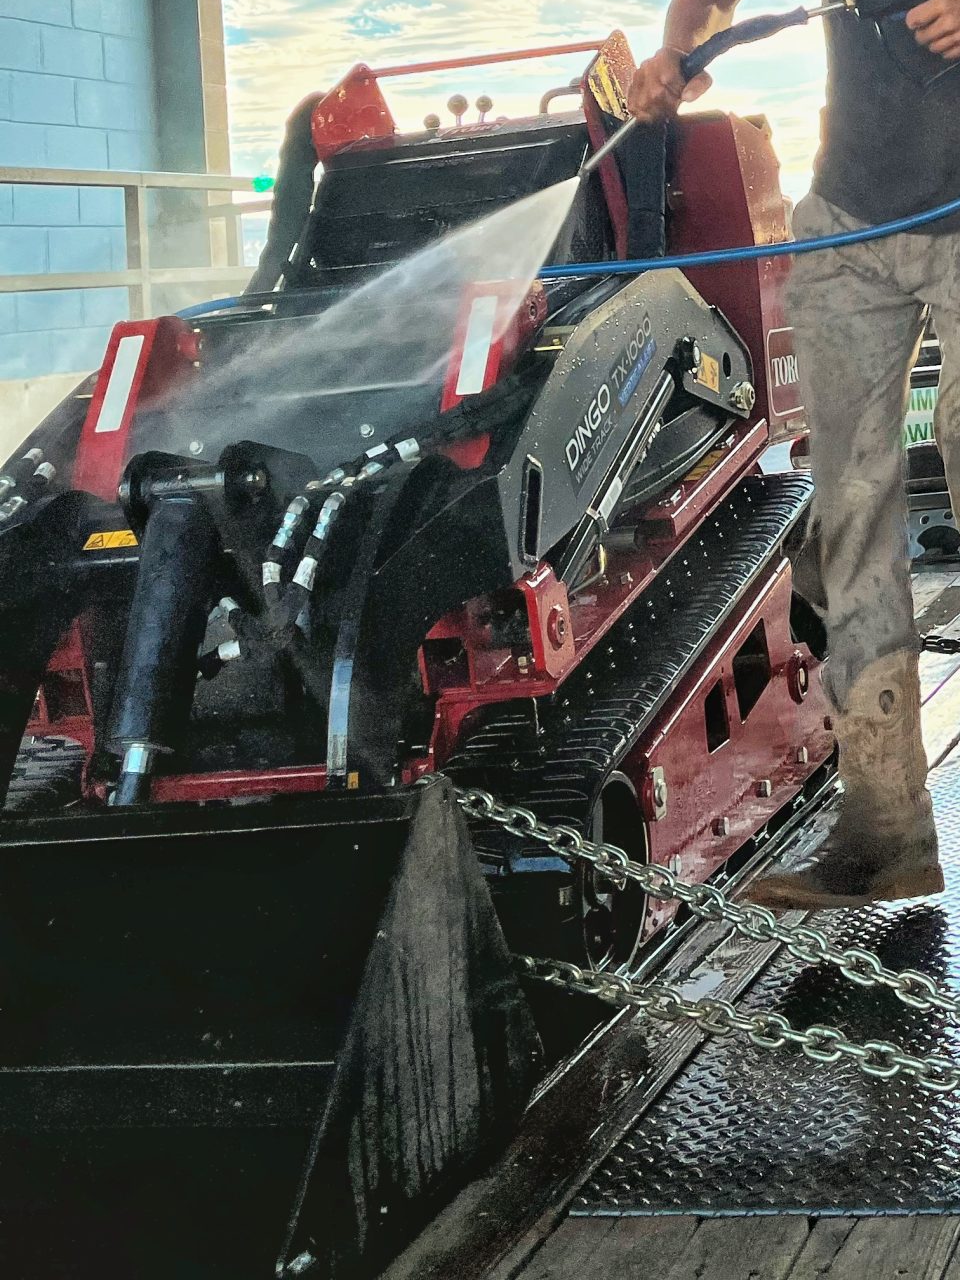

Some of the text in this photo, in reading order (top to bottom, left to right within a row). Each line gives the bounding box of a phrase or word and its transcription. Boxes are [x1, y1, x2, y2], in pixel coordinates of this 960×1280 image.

[771, 354, 800, 388] TOR
[565, 384, 611, 471] DINGO
[575, 416, 614, 484] WIDE TRACK
